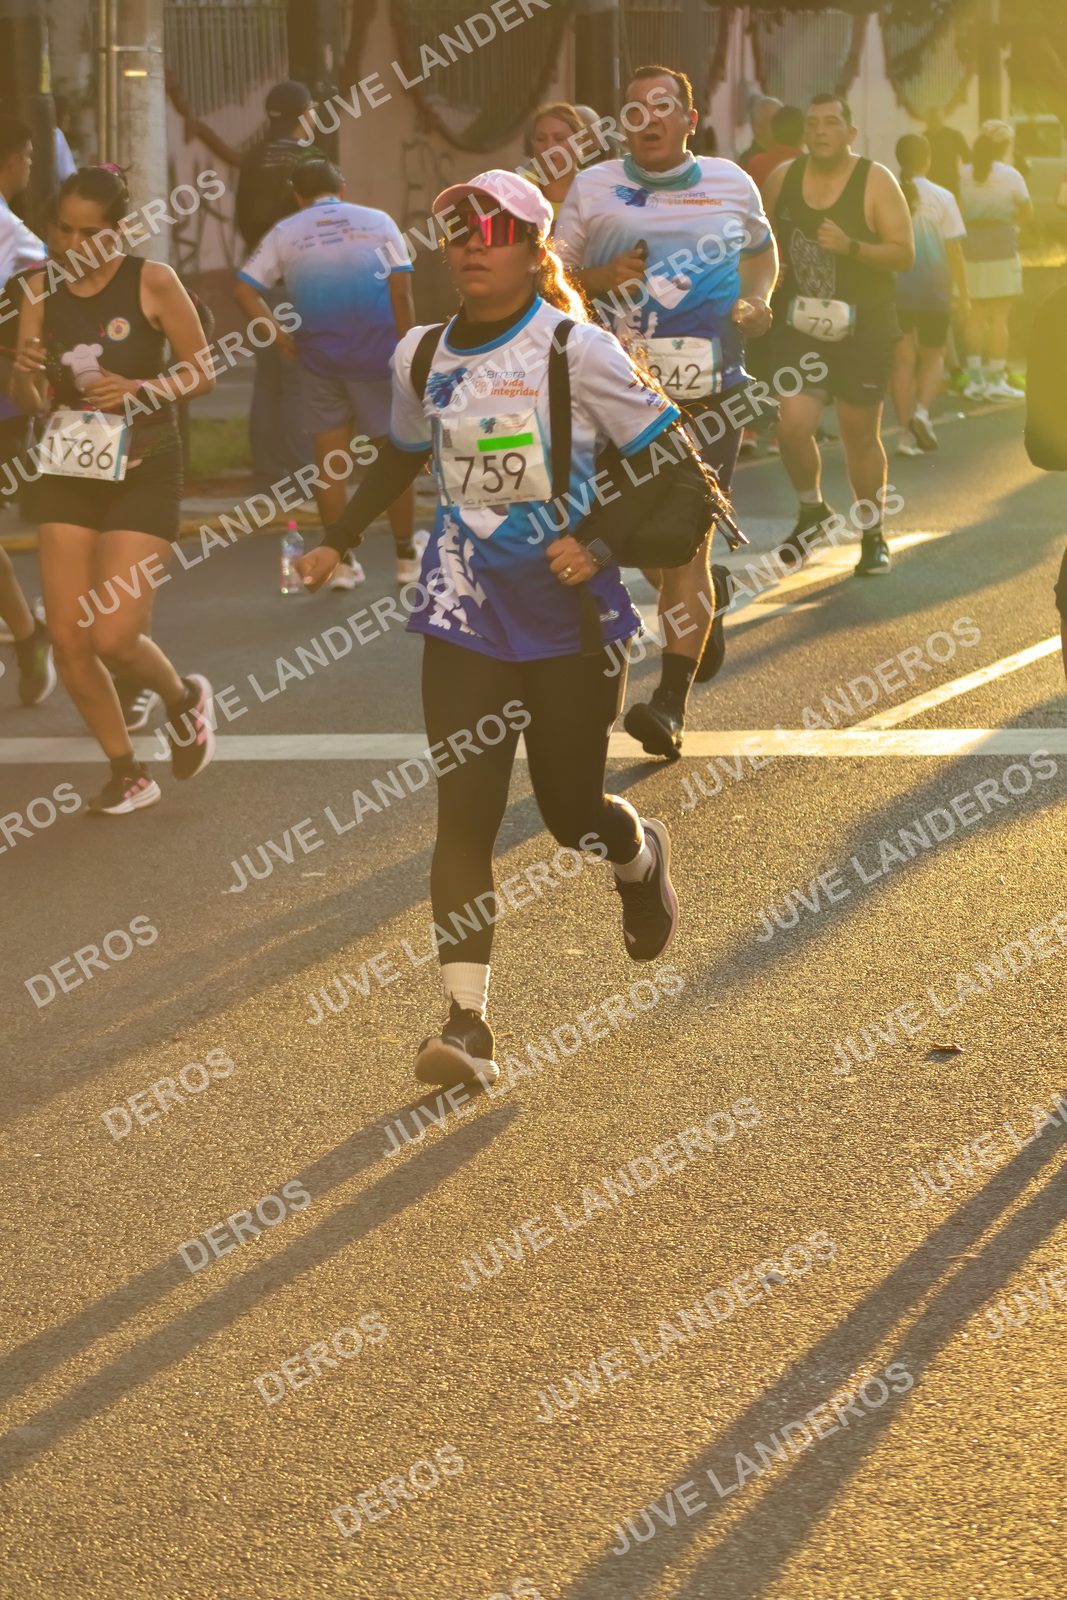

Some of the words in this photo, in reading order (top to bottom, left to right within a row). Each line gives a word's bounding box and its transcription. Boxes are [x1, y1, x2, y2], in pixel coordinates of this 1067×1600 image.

[808, 316, 834, 337] 72
[49, 436, 114, 470] 1786
[454, 452, 527, 495] 759
